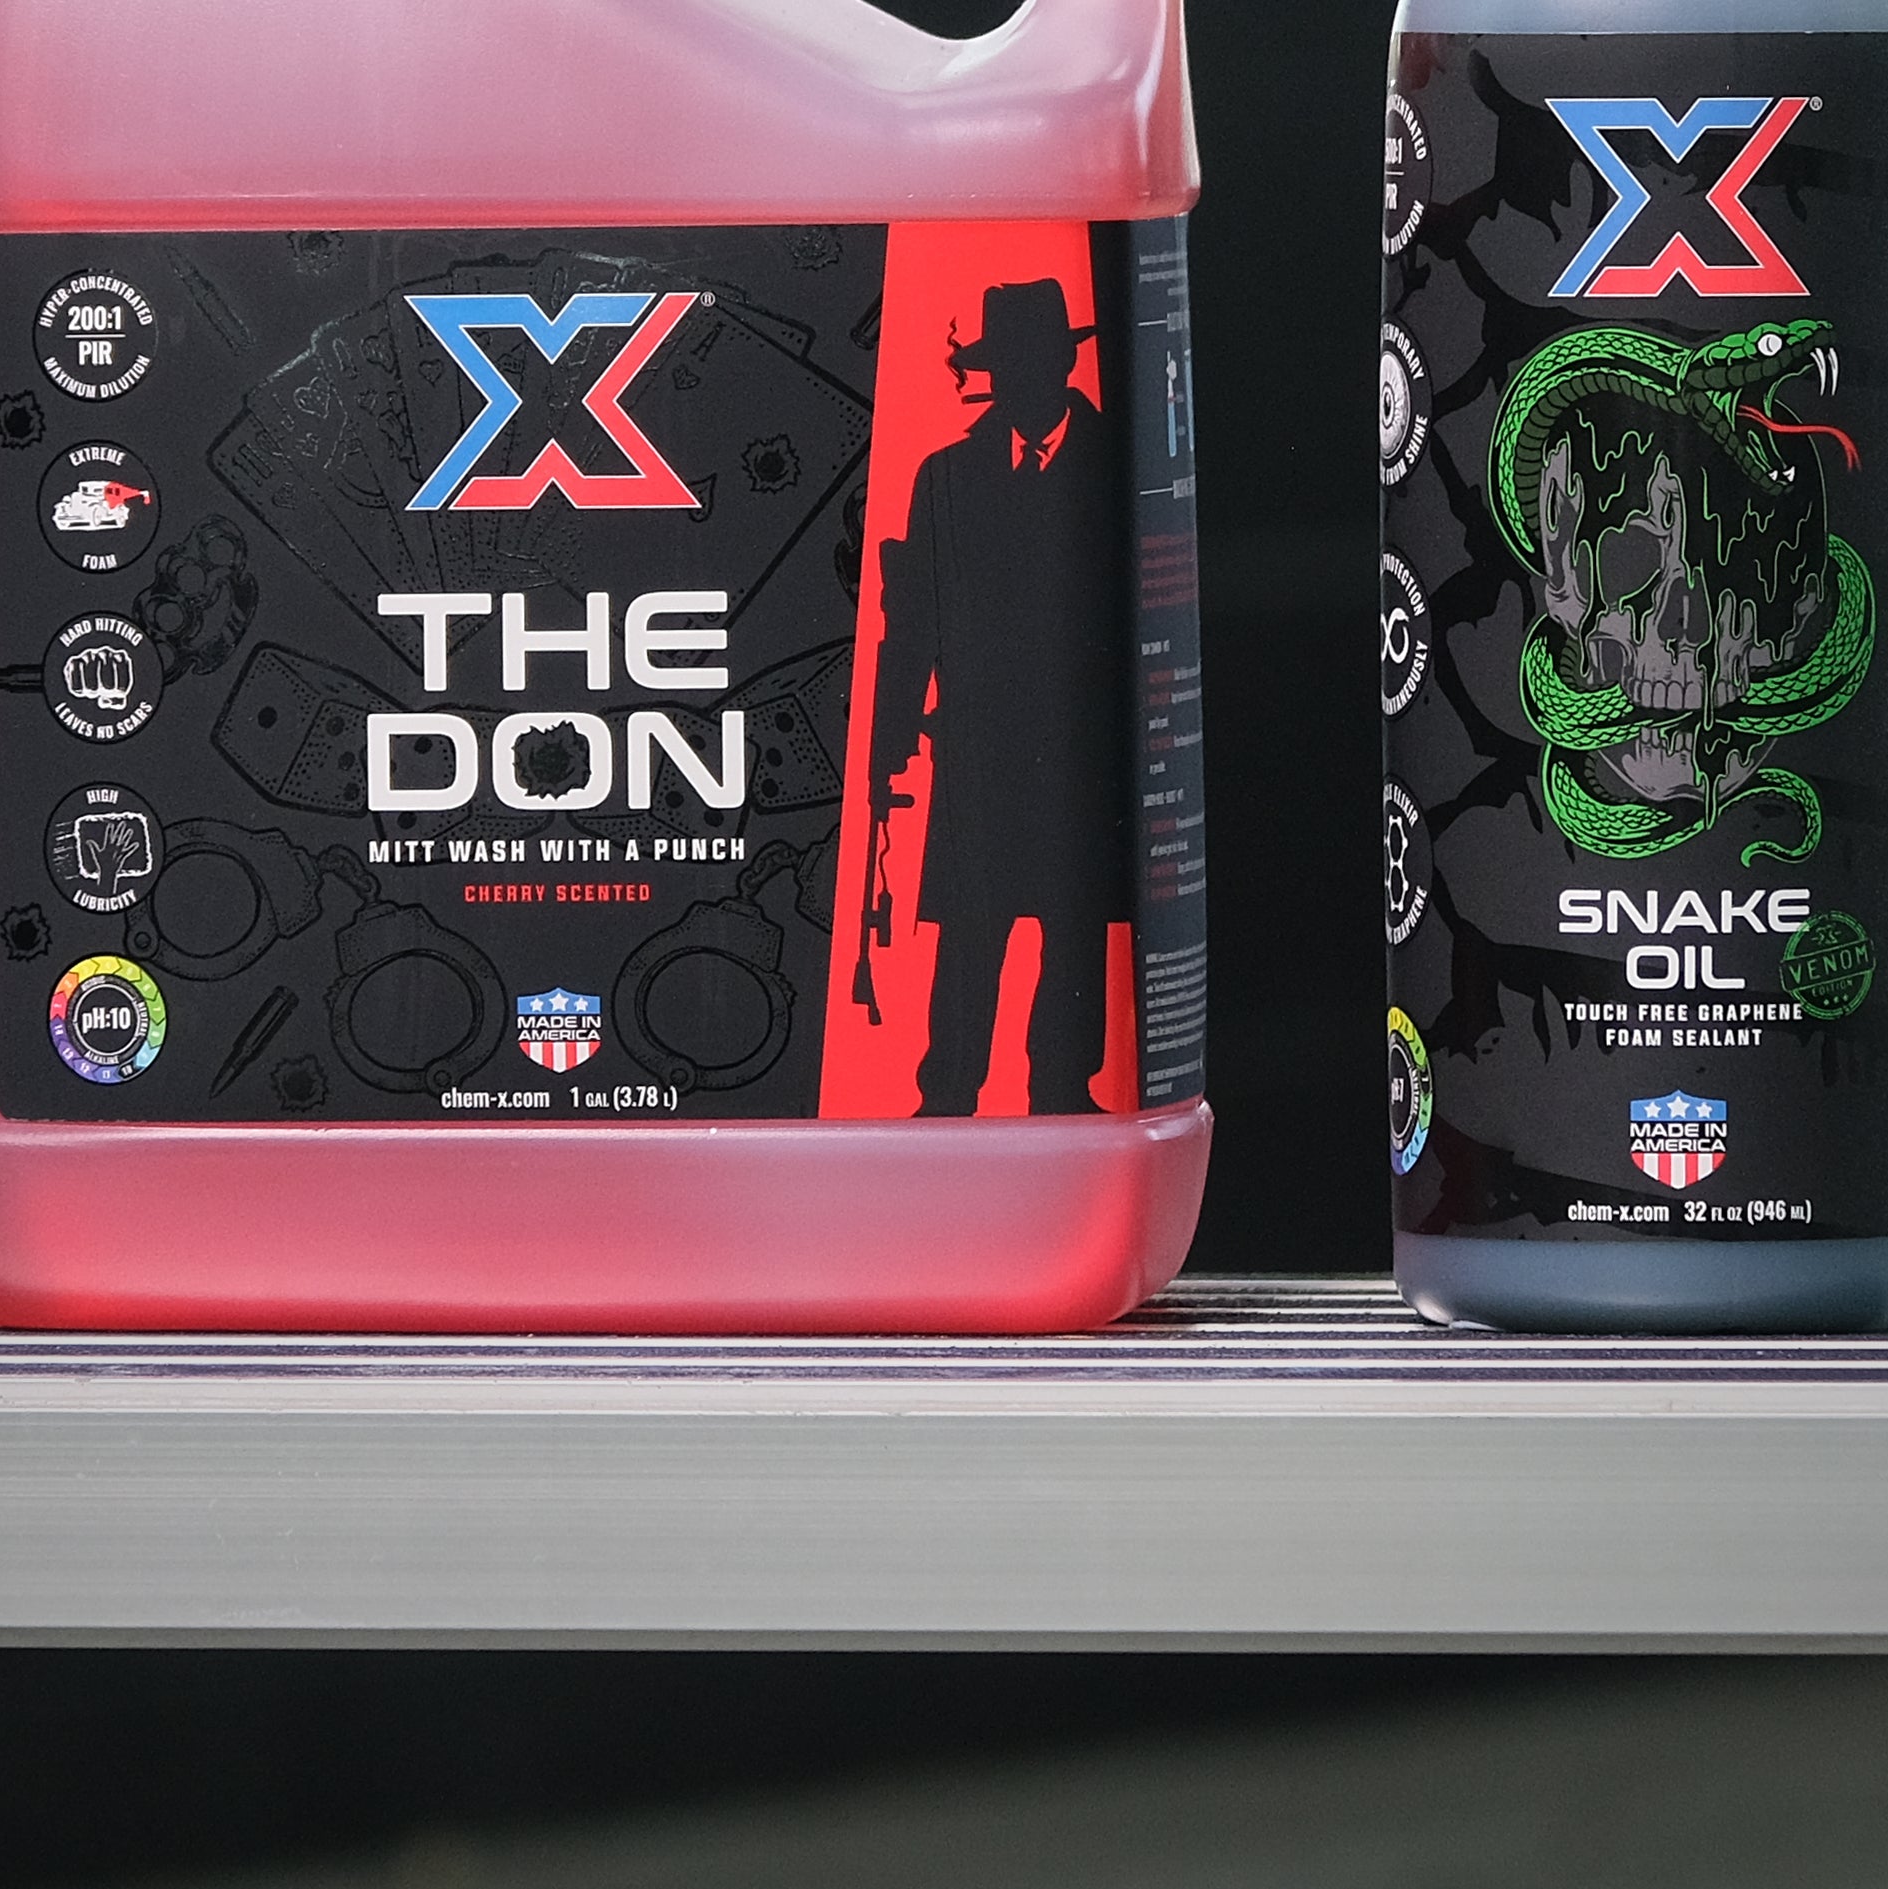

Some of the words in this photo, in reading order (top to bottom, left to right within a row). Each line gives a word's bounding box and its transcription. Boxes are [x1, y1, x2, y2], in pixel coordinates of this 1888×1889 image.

[38, 275, 153, 328] HYPER-CONCENTRATED
[67, 305, 122, 331] 200:1
[78, 340, 113, 366] PIR
[43, 356, 96, 398] MAXIMUM
[100, 354, 151, 398] DILUTION
[1405, 414, 1428, 464] SHINE
[68, 446, 126, 467] EXTREME
[82, 553, 117, 570] FOAM
[59, 619, 92, 647] HARD
[94, 617, 144, 646] HITTING
[377, 590, 729, 691] THE
[54, 702, 94, 737] LEAVES
[97, 725, 114, 739] NO
[116, 701, 153, 736] SCARS
[367, 710, 745, 811] DON
[86, 788, 119, 804] HIGH
[368, 839, 435, 863] MITT
[448, 839, 526, 863] WASH
[540, 838, 610, 862] WITH
[624, 838, 640, 861] A
[653, 837, 745, 861] PUNCH
[72, 889, 137, 912] LUBRICITY
[464, 884, 546, 903] CHERRY
[556, 883, 651, 902] SCENTED
[1558, 888, 1811, 934] SNAKE
[1625, 945, 1746, 990] OIL
[1788, 944, 1869, 984] VENOM
[1811, 979, 1853, 998] EDITION
[81, 1007, 131, 1034] pH:10
[517, 1016, 579, 1029] MADE
[582, 1015, 602, 1028] IN
[1564, 1003, 1628, 1022] TOUCH
[1638, 1003, 1689, 1022] FREE
[1697, 1002, 1803, 1022] GRAPHENE
[517, 1029, 602, 1041] AMERICA
[1605, 1028, 1662, 1047] FOAM
[1672, 1028, 1763, 1046] SEALANT
[441, 1087, 550, 1109] chem-x.com
[569, 1086, 580, 1108] 1
[585, 1093, 610, 1108] GAL
[613, 1085, 659, 1112] (3.78
[1630, 1123, 1700, 1138] MADE
[1704, 1123, 1728, 1137] IN
[1630, 1139, 1727, 1152] AMERICA
[1567, 1200, 1670, 1223] chem-x.com
[1684, 1200, 1708, 1222] 32
[1711, 1206, 1725, 1222] FL
[1727, 1206, 1743, 1222] OZ
[1746, 1200, 1787, 1225] (946
